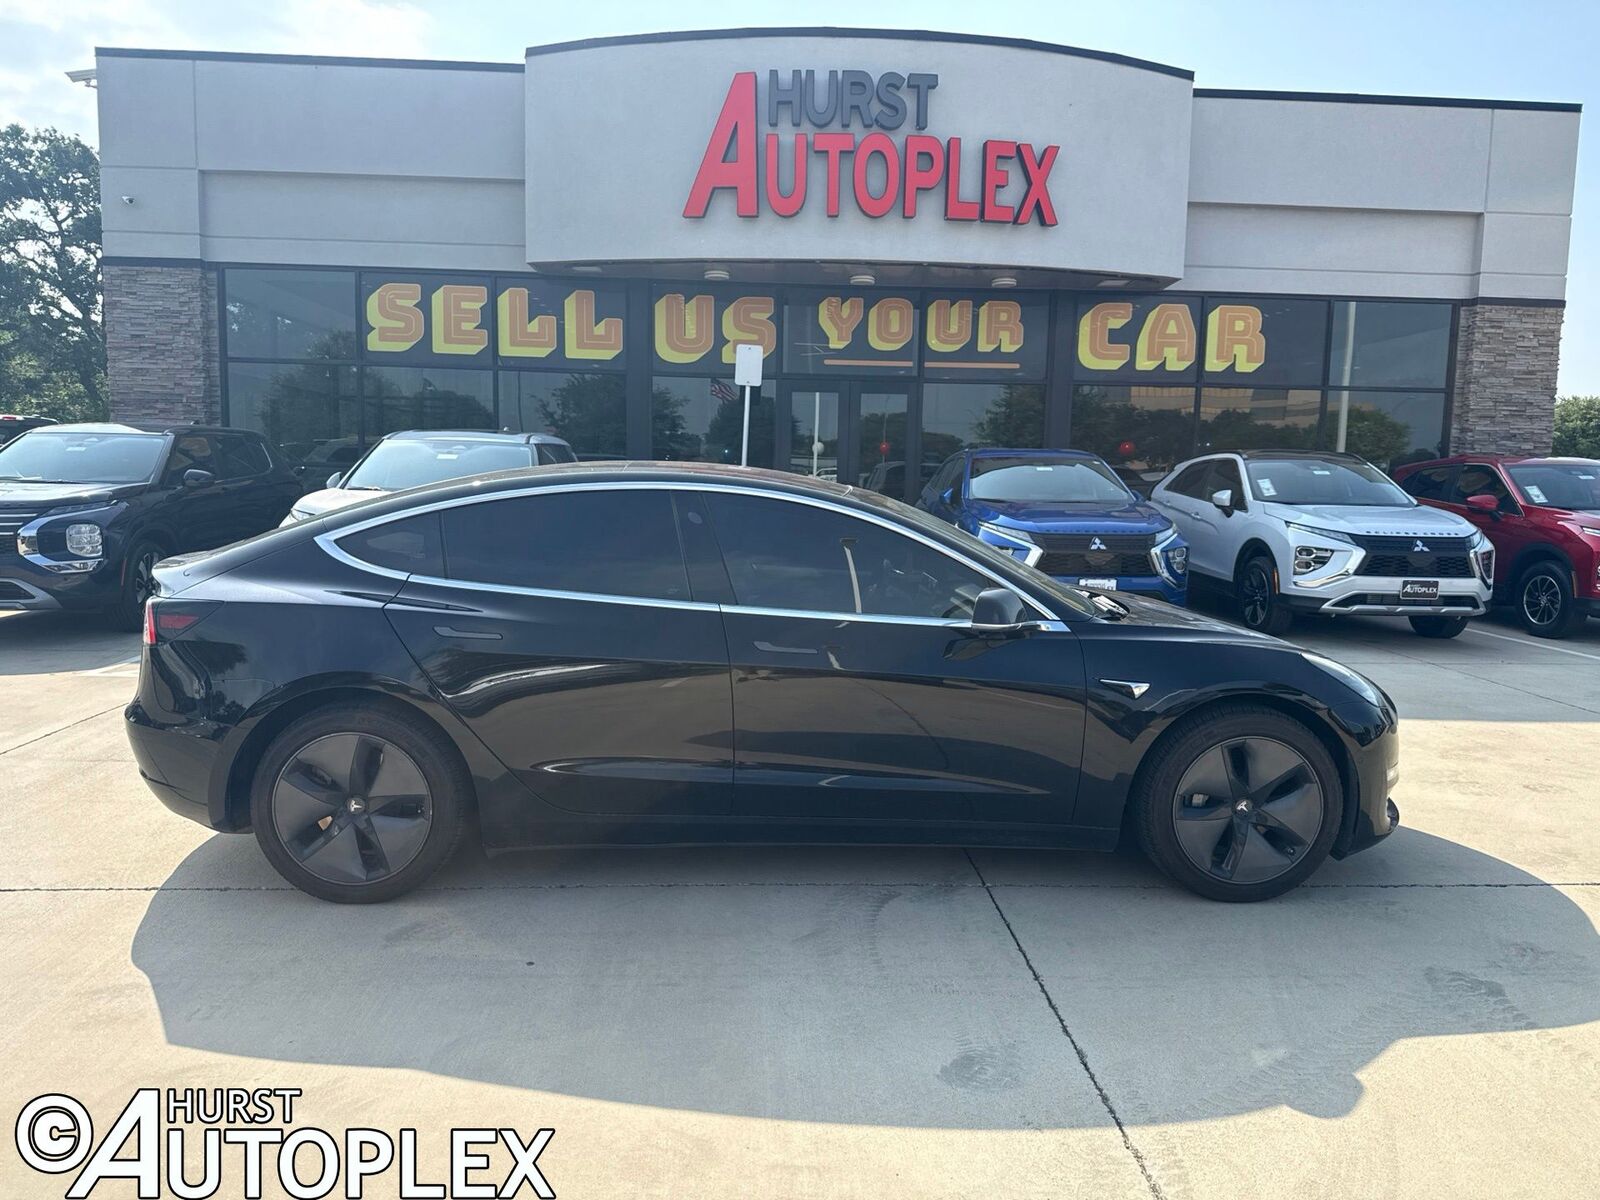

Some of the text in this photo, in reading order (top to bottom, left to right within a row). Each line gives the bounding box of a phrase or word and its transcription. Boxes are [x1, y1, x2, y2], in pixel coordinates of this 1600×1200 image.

[768, 69, 939, 131] HURST
[682, 71, 1060, 227] AUTOPLEX
[366, 283, 1266, 373] SELL US YOUR CAR
[1403, 584, 1438, 593] AUTOPLEX
